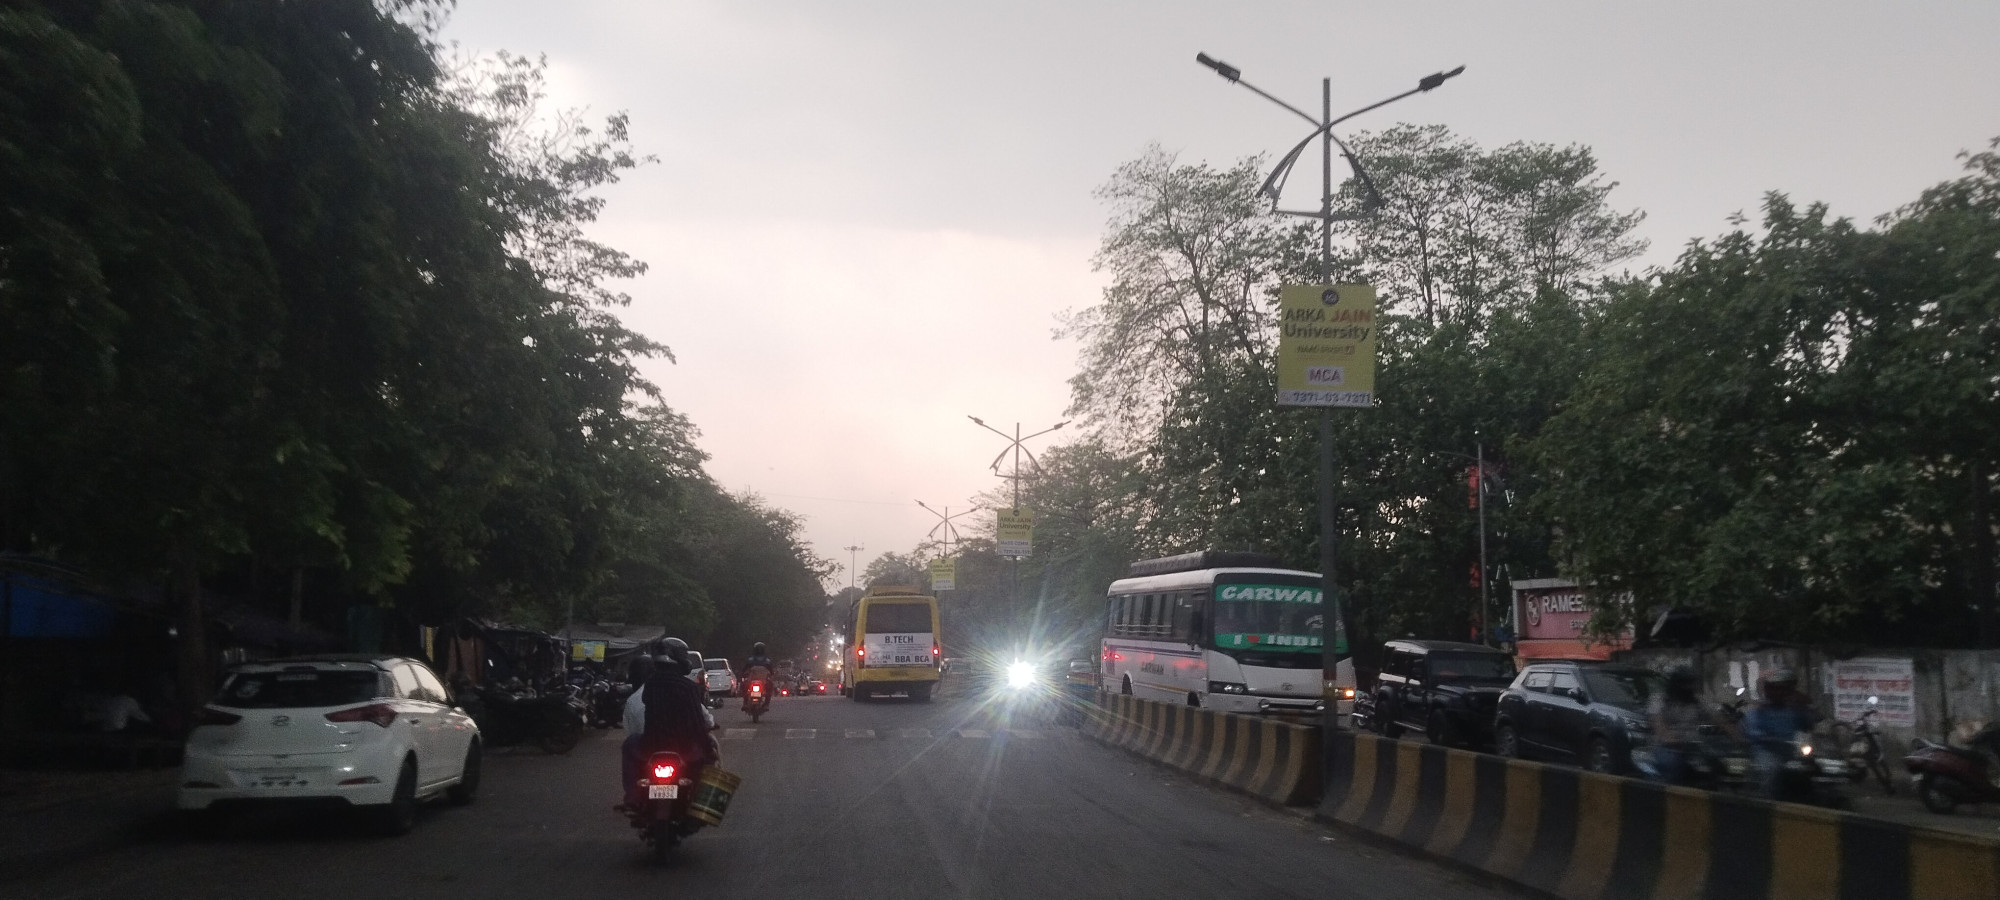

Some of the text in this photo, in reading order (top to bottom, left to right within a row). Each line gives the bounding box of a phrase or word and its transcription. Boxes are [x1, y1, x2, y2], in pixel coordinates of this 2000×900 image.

[1284, 308, 1373, 323] ARKA JAIN
[1284, 323, 1371, 342] University
[1309, 369, 1341, 382] MCA
[999, 522, 1031, 530] University
[884, 635, 914, 644] B.TECH
[1233, 634, 1324, 646] I INDI
[894, 655, 911, 663] BBA
[914, 655, 930, 663] BCA
